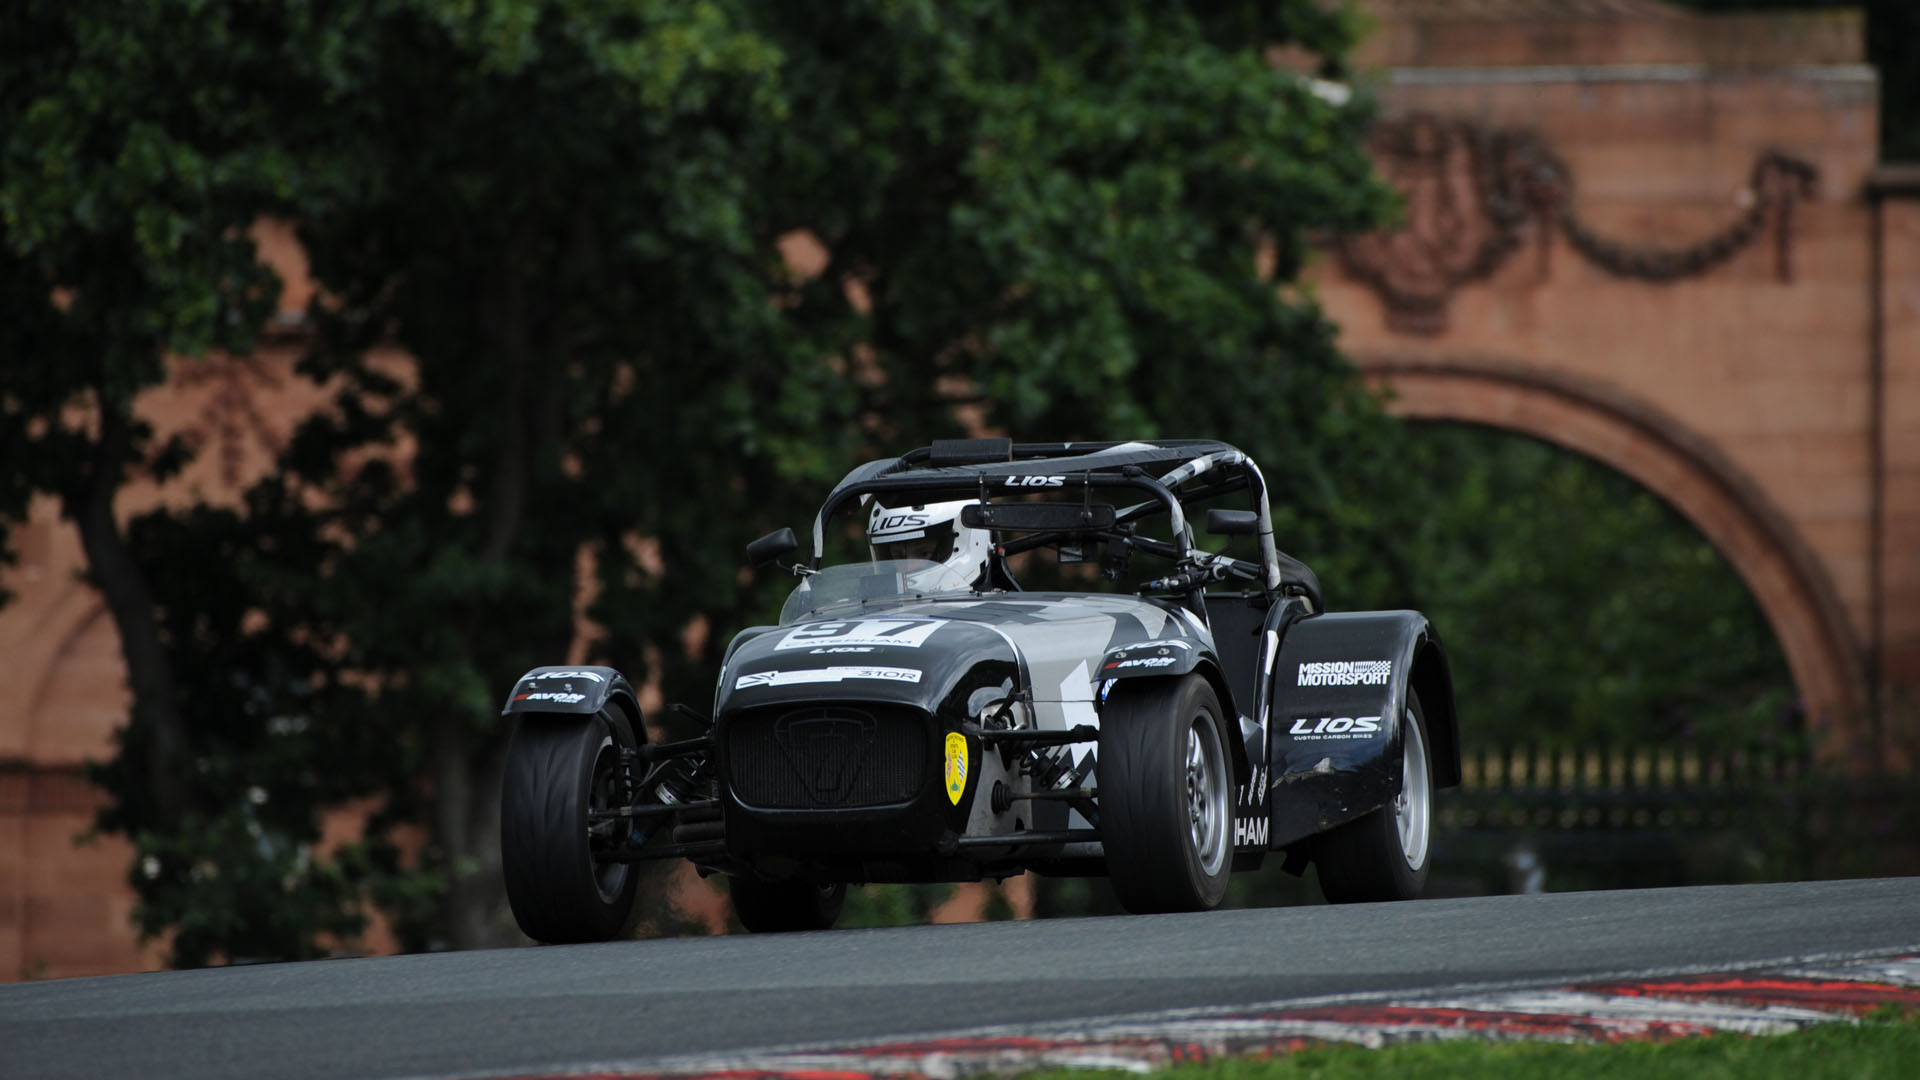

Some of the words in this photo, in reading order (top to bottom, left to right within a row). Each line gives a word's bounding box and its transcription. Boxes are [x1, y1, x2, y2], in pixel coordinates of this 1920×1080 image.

[1004, 475, 1066, 486] LIOS
[871, 514, 930, 533] LIOS
[792, 619, 937, 639] 97
[1299, 661, 1355, 674] MISSION
[857, 670, 917, 680] 310R
[1297, 672, 1390, 687] MOTORSPORT
[526, 692, 586, 702] AVON
[1289, 716, 1382, 735] LIOS
